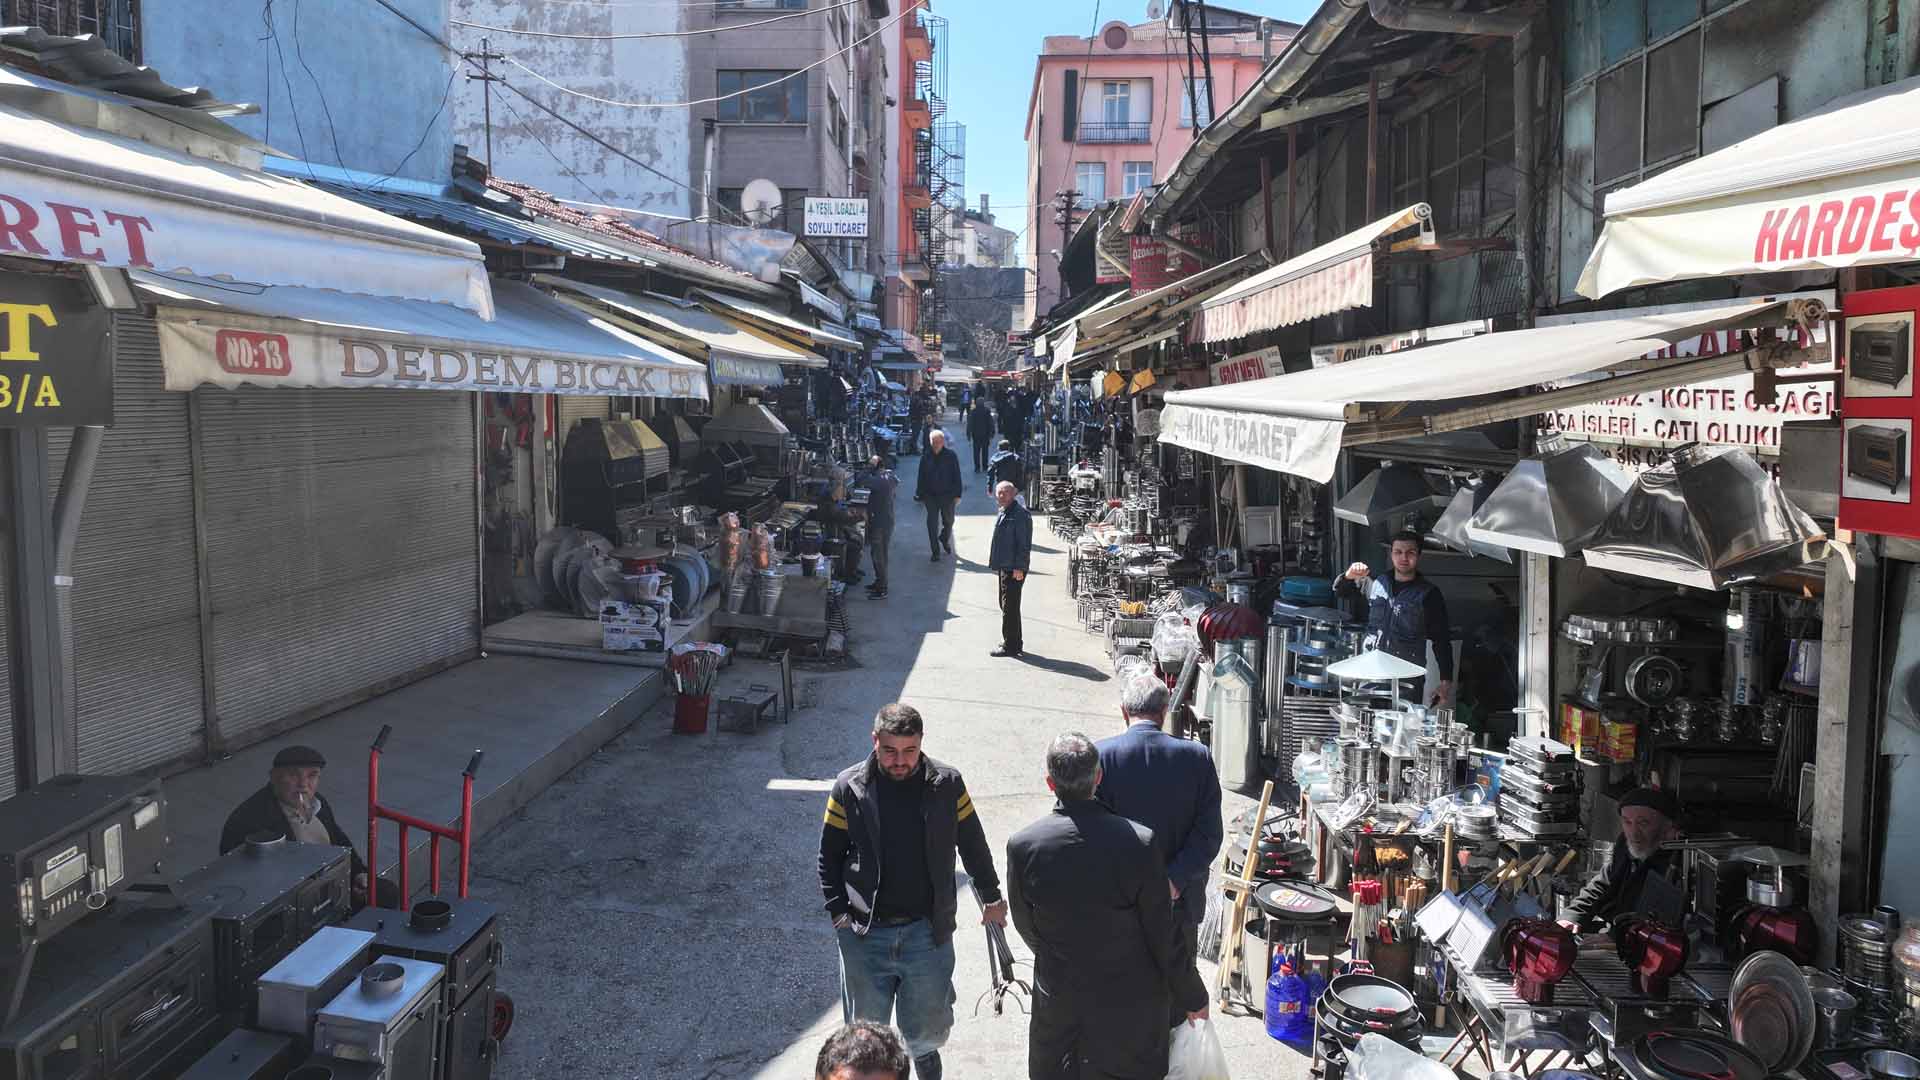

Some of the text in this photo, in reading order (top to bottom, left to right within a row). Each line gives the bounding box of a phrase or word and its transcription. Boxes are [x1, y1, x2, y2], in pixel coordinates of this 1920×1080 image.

[808, 221, 866, 234] SOYLU TİCARET
[225, 336, 284, 369] NO:13
[339, 338, 541, 388] DEDEM
[1661, 385, 1735, 411] KÖFTE
[1223, 411, 1297, 463] TİCARET
